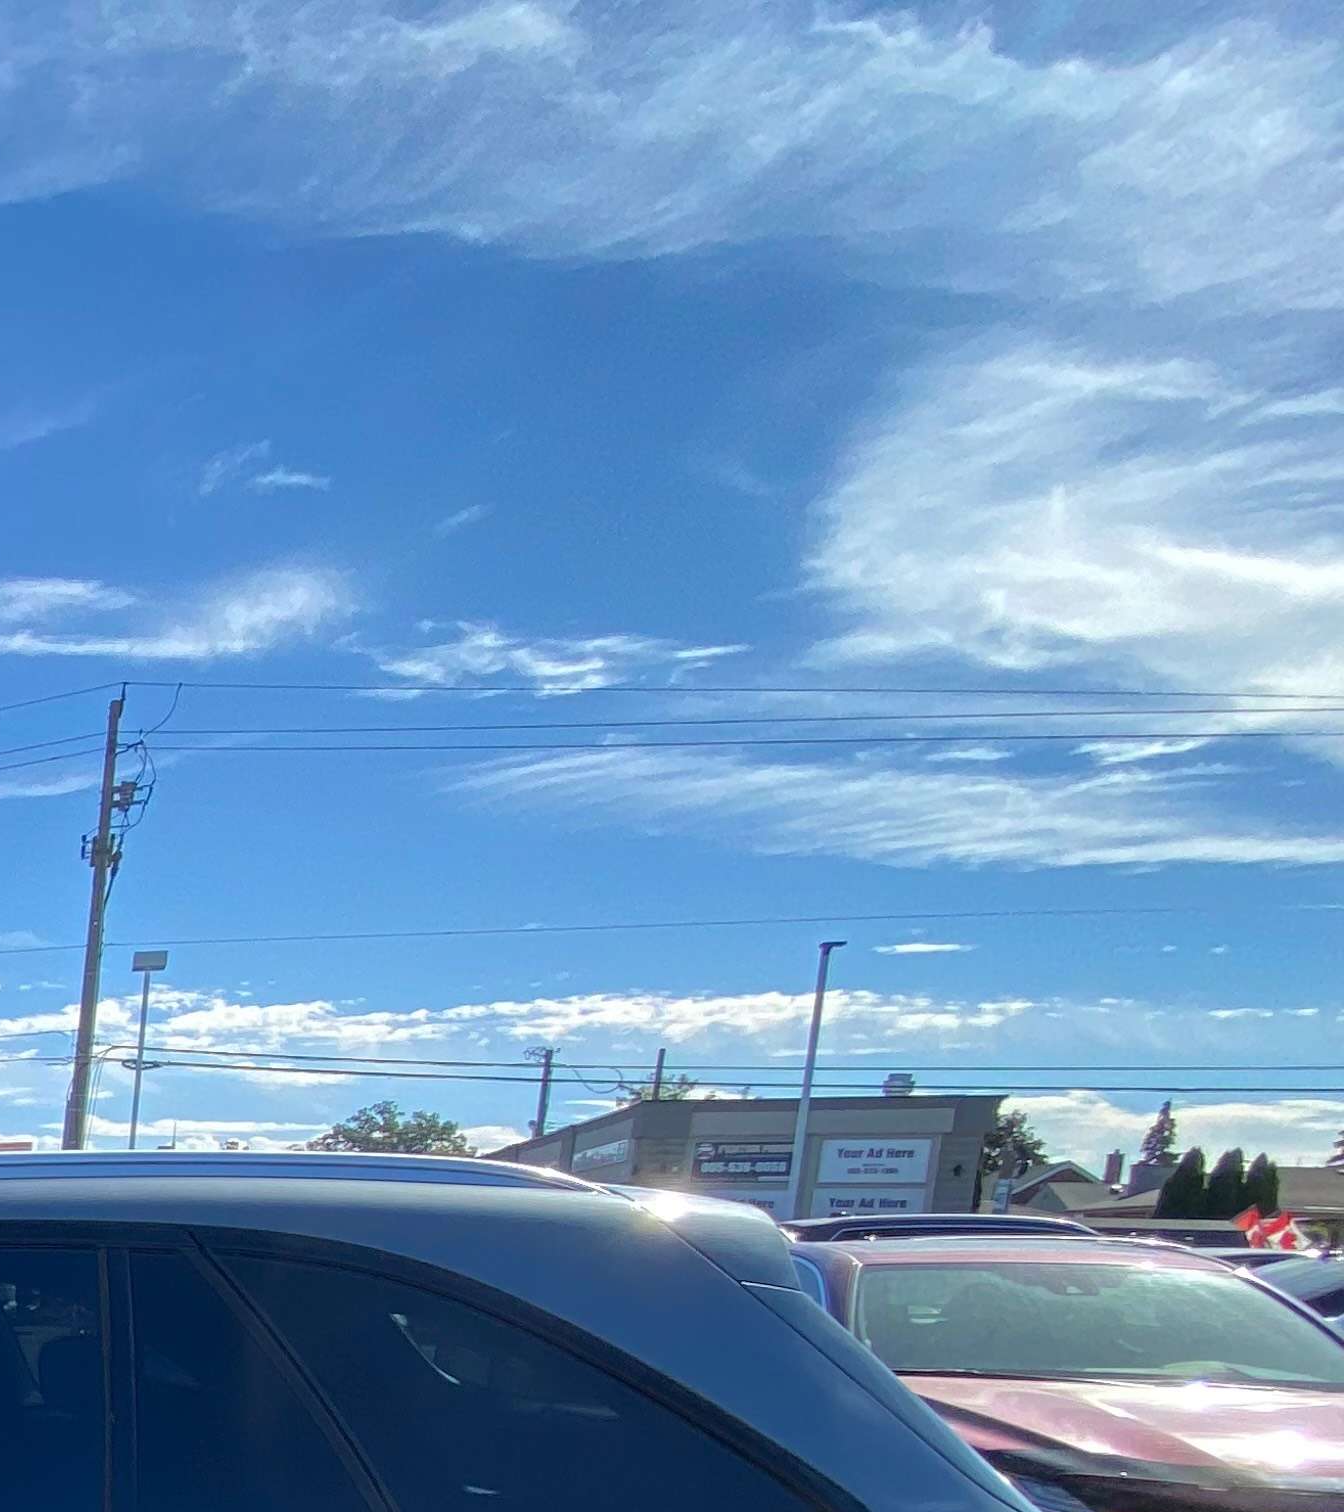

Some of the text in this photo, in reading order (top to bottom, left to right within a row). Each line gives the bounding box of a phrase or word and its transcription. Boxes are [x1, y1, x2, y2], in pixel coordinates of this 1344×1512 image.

[837, 1148, 915, 1159] Your Ad Here
[829, 1198, 855, 1208] Your
[858, 1198, 875, 1208] Ad
